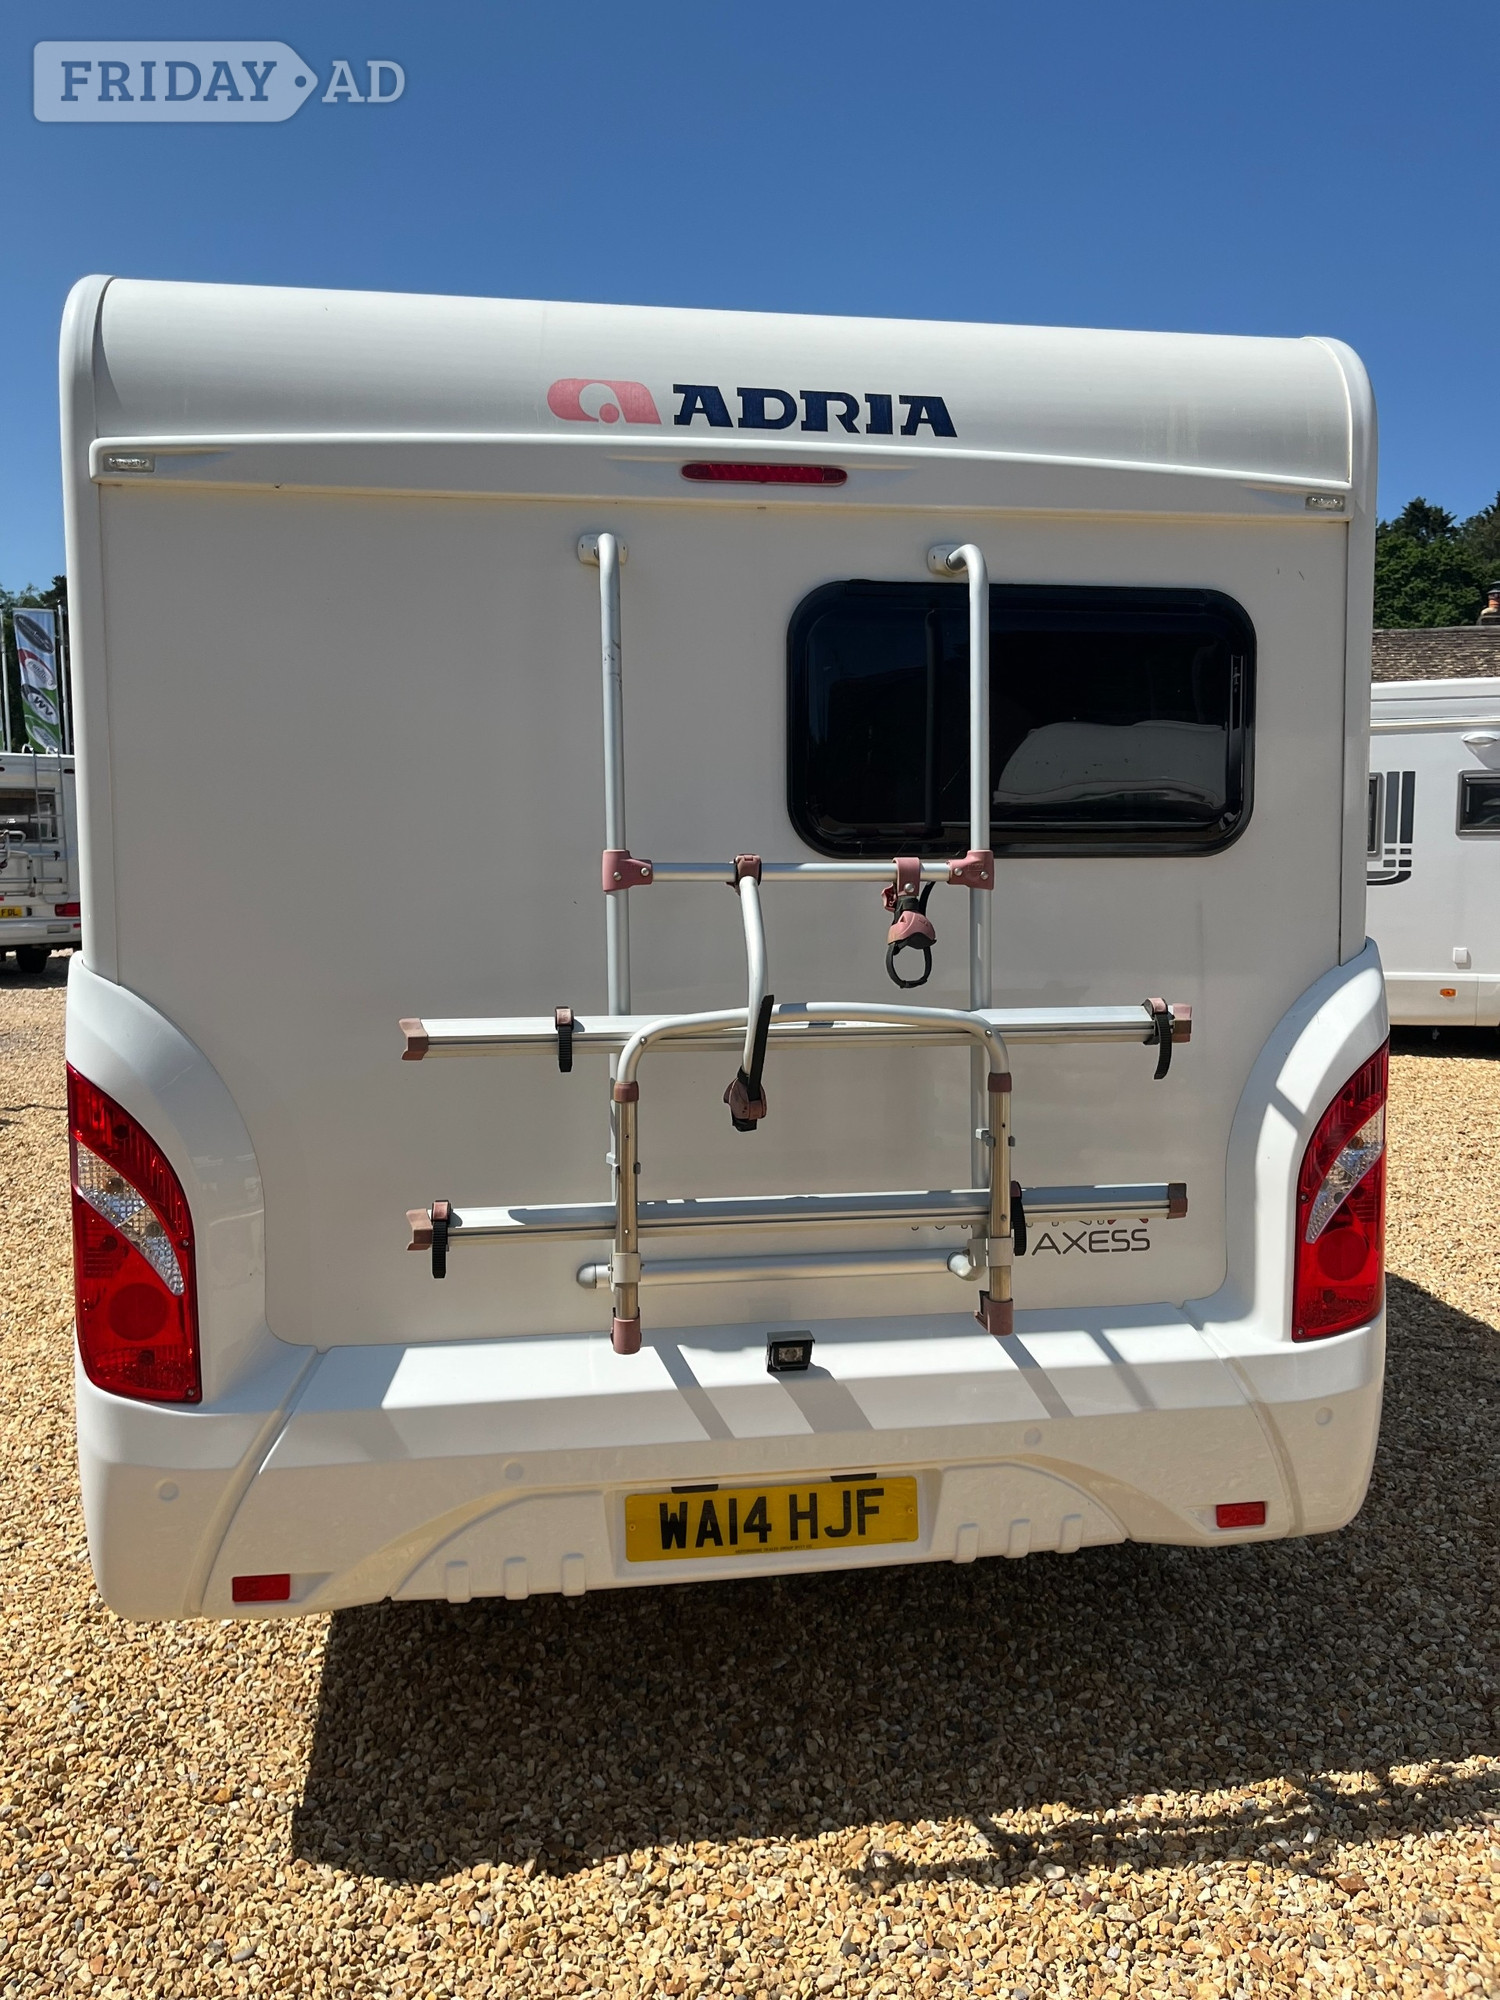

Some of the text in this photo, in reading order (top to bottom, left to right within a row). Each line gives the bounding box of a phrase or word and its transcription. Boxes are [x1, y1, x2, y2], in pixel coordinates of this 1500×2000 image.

[672, 383, 958, 438] ADRIA
[1031, 1228, 1151, 1257] AXESS
[658, 1487, 885, 1551] WA14 HJF
